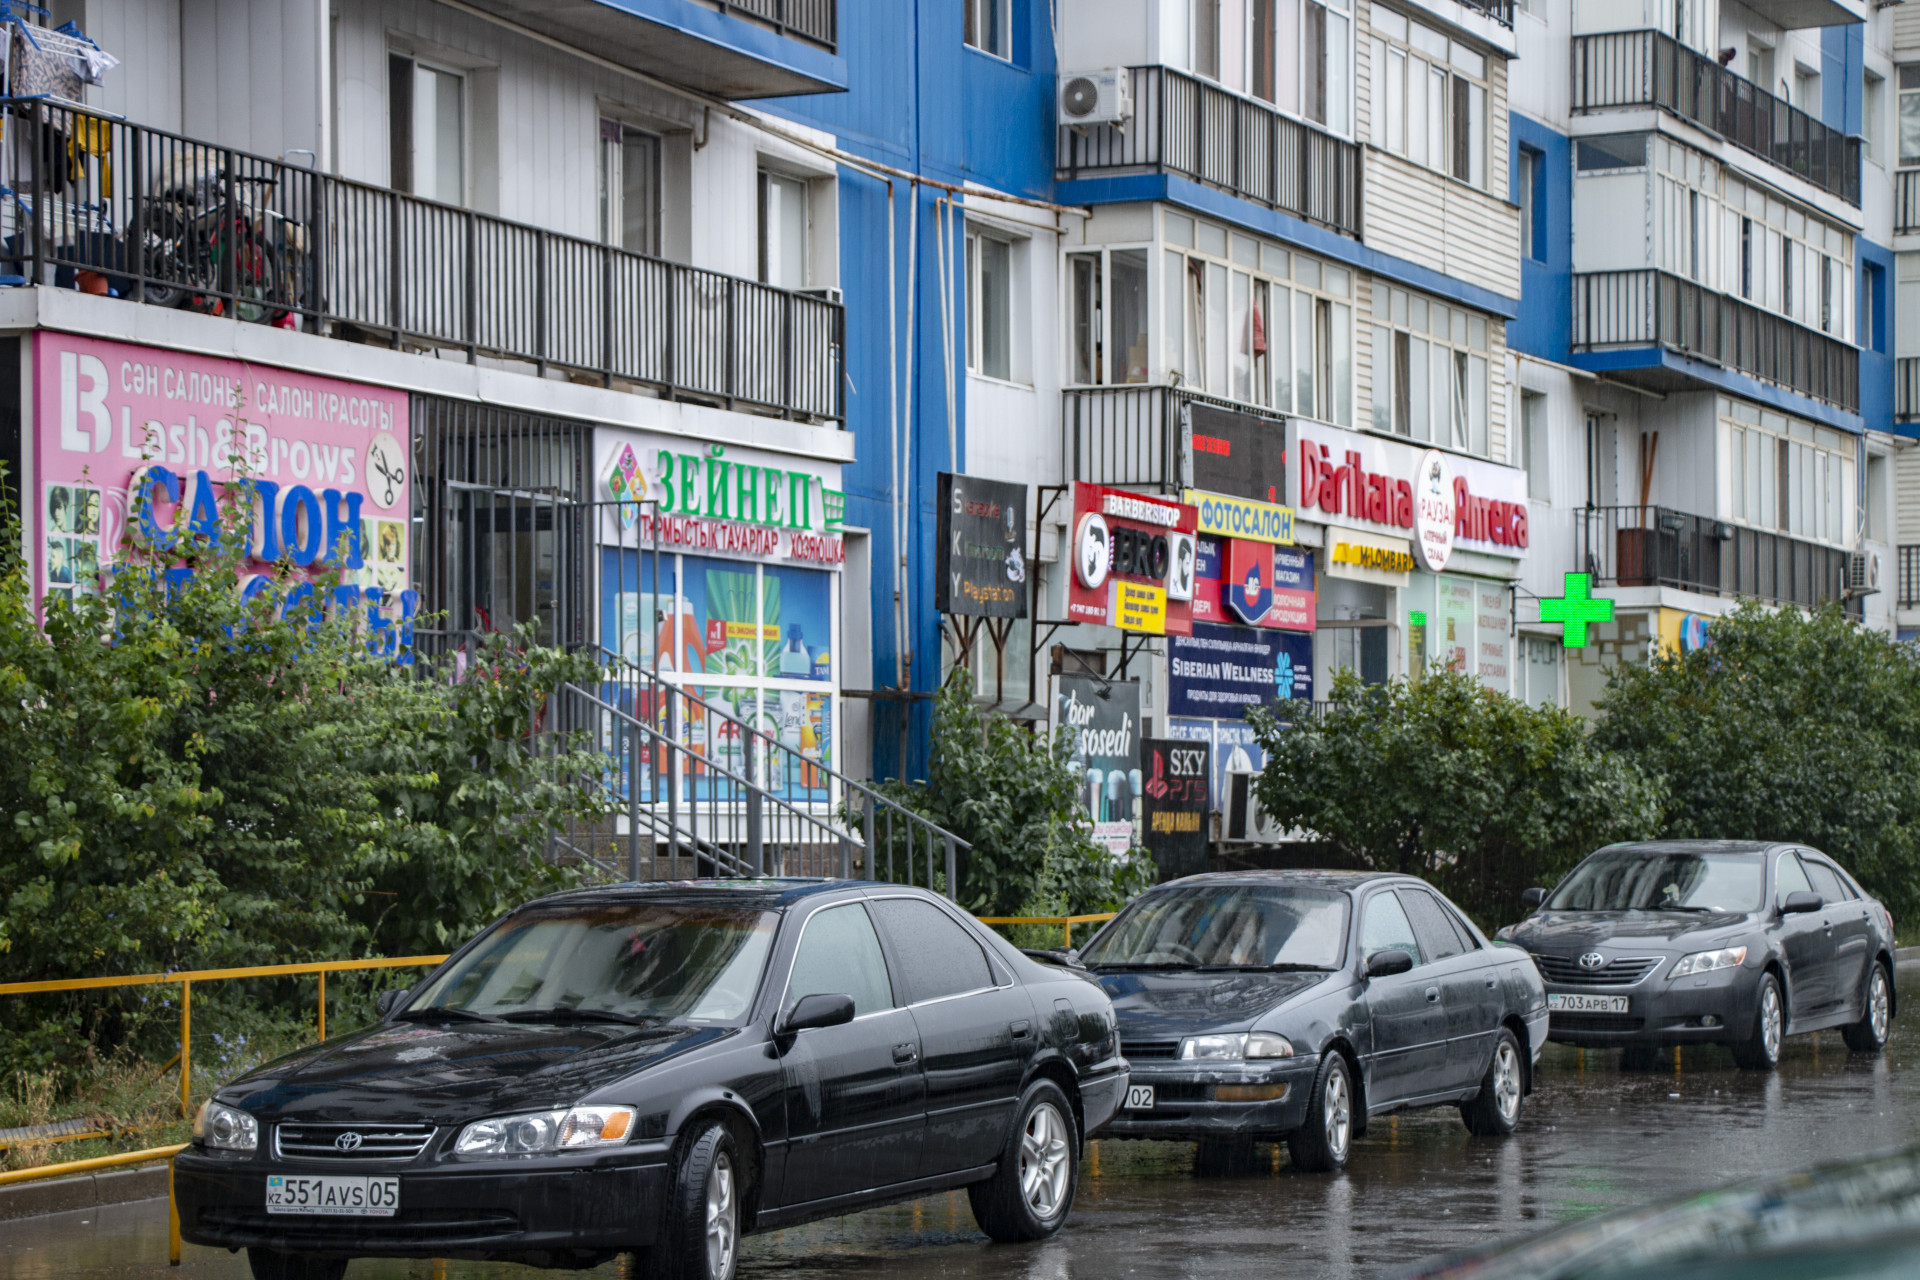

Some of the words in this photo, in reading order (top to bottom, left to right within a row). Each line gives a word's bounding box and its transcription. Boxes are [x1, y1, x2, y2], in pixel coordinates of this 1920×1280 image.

[120, 360, 159, 397] СӘН
[163, 367, 242, 407] САЛОНЫ
[256, 382, 315, 419] САЛОН
[317, 392, 395, 431] КРАСОТЫ
[656, 444, 813, 530] ЗЕЙНЕП
[1109, 494, 1180, 527] BARBERSHOP
[1201, 498, 1292, 540] ФОТОСАЛОН
[721, 524, 779, 555] ТАУАРЛАР
[789, 532, 847, 563] ХОЗЯЮШКА
[1112, 526, 1169, 579] BRO
[1275, 553, 1305, 568] ИРМЕННЫЙ
[1275, 570, 1300, 583] МАГАЗИН
[1172, 657, 1220, 680] SIBERIAN
[1221, 662, 1274, 684] WELLNESS
[1068, 689, 1095, 725] bar
[1080, 712, 1132, 757] sosedi
[1170, 749, 1206, 776] SKY
[1169, 779, 1206, 802] PS5
[1611, 998, 1627, 1011] 17
[1131, 1088, 1152, 1106] 02
[268, 1193, 282, 1204] KZ
[369, 1181, 397, 1207] 05
